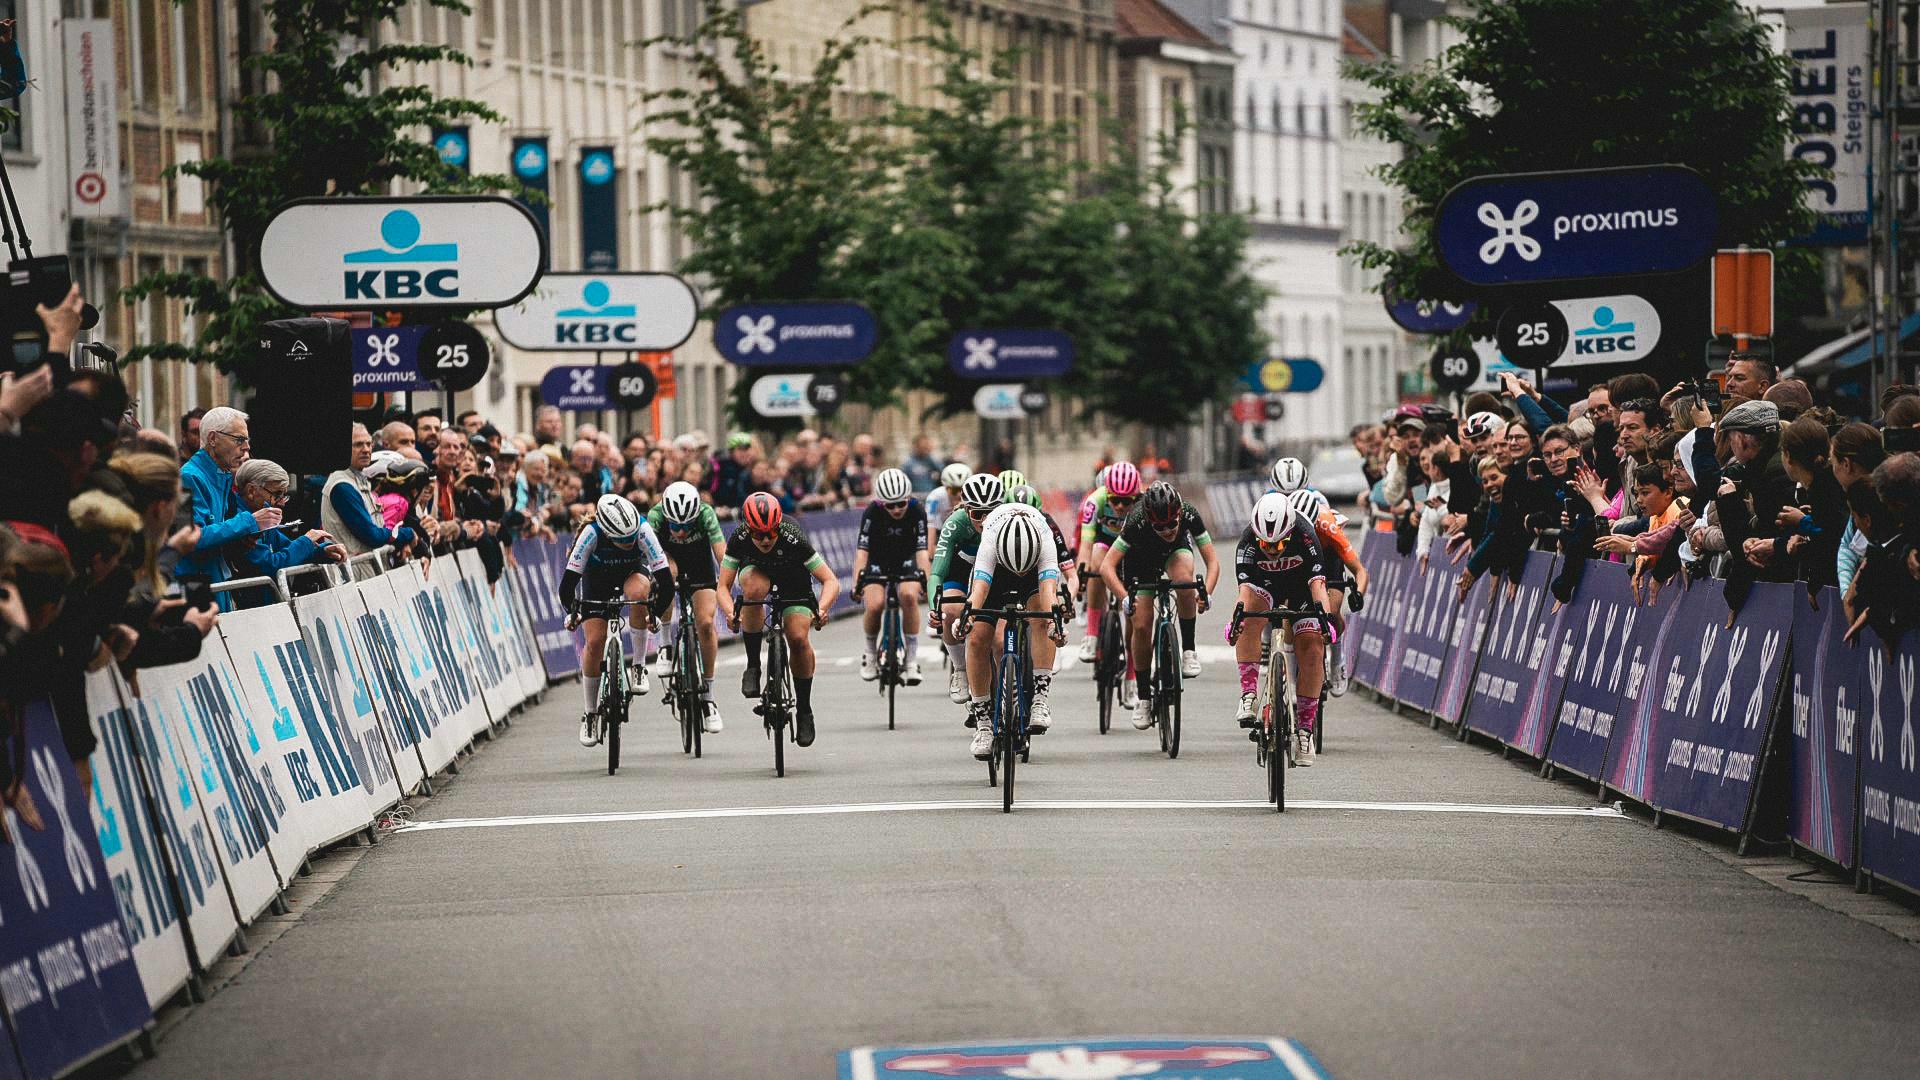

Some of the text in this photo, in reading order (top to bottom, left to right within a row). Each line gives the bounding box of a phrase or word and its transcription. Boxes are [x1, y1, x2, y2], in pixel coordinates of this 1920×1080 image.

[1791, 29, 1837, 206] JOBEL
[1843, 65, 1867, 155] Steigers
[1554, 207, 1678, 240] proximus
[344, 269, 459, 300] KBC
[556, 323, 637, 343] KBC
[1517, 322, 1549, 347] 25
[1574, 335, 1636, 355] KBC
[436, 344, 470, 369] 25
[1442, 357, 1468, 376] 50
[353, 371, 417, 386] proximus
[619, 377, 645, 396] 50
[559, 396, 606, 407] proximus
